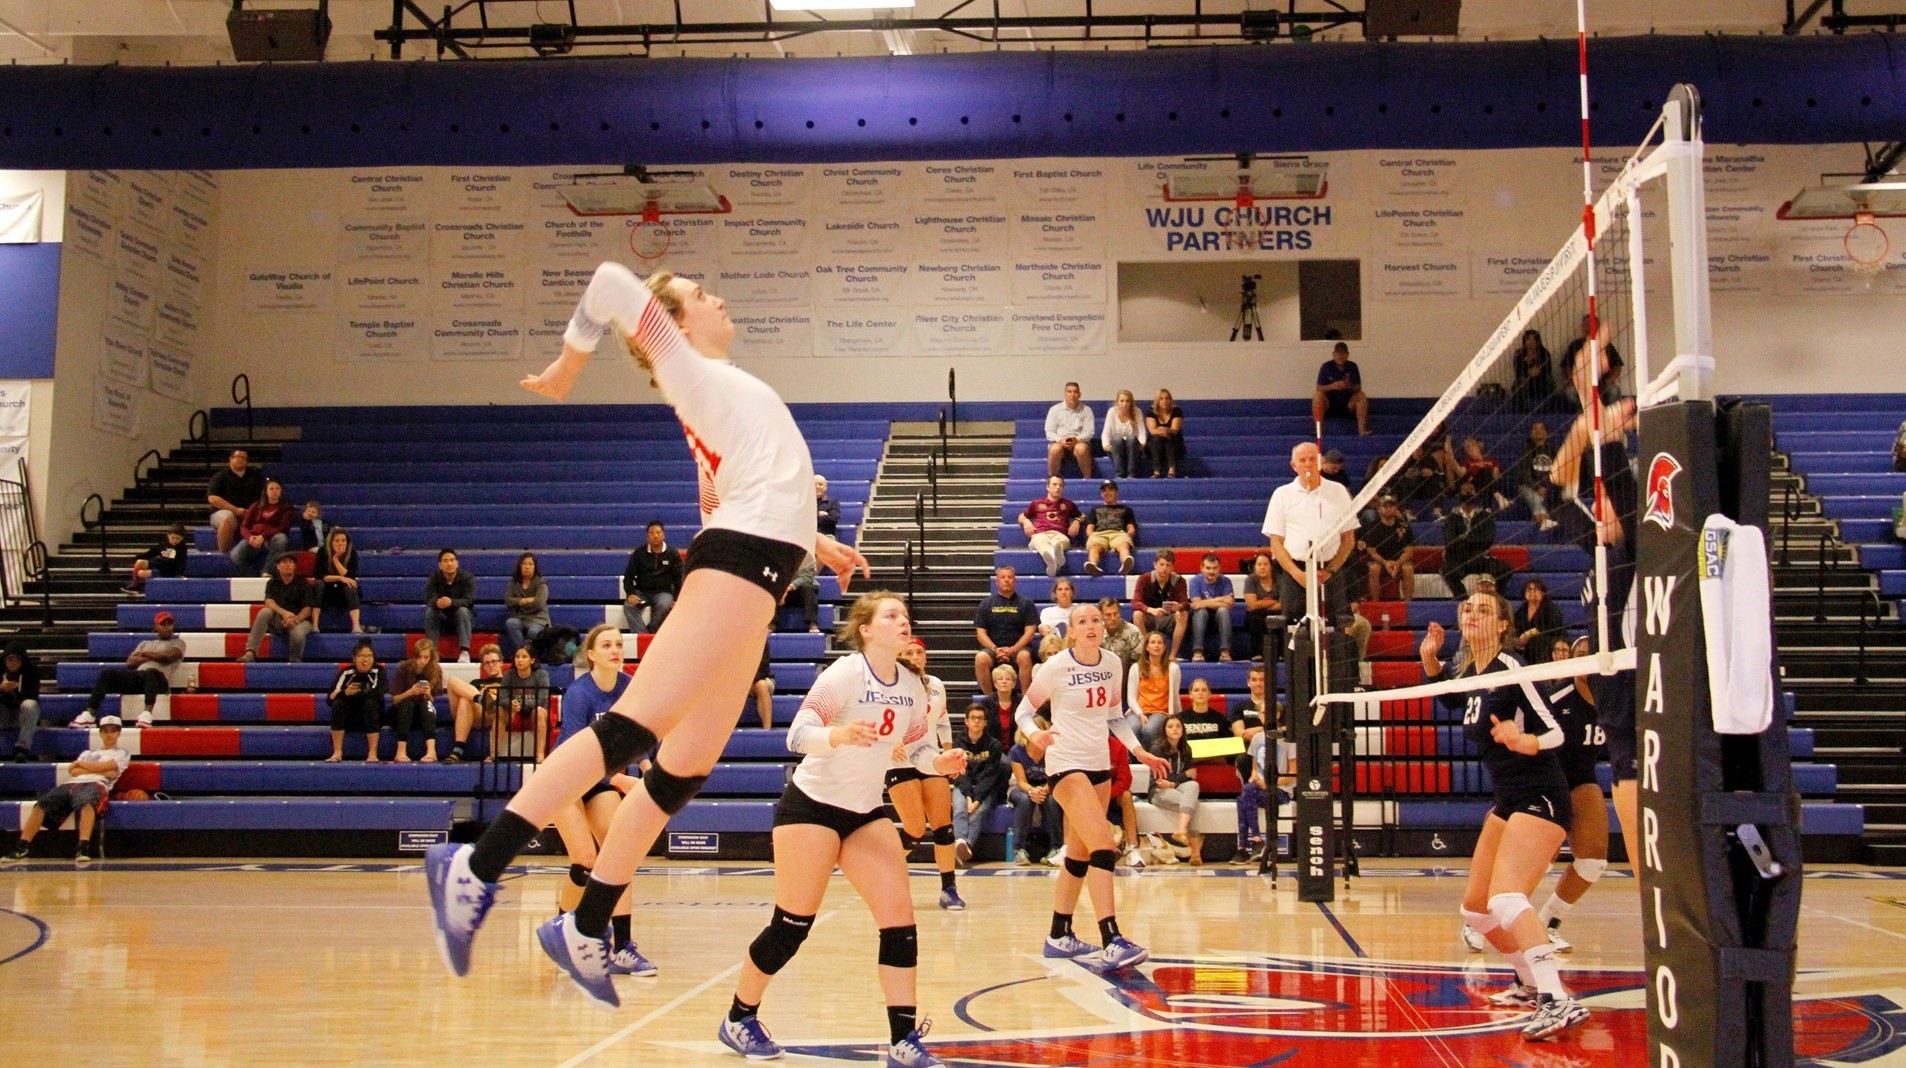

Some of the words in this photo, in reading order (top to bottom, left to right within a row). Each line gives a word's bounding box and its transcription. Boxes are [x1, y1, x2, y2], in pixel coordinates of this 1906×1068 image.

[1157, 162, 1207, 170] Community
[1380, 159, 1412, 167] Central
[823, 168, 849, 177] Christ
[852, 168, 902, 178] Community
[926, 166, 949, 174] Ceres
[951, 165, 994, 174] Christian
[1014, 170, 1033, 178] First
[1036, 170, 1068, 179] Baptist
[1070, 169, 1102, 178] Church
[385, 175, 423, 183] Christian
[451, 175, 470, 183] First
[473, 174, 511, 182] Christian
[730, 171, 761, 179] Destiny
[944, 175, 976, 183] Church
[846, 177, 878, 186] Church
[371, 184, 402, 193] Church
[465, 184, 496, 192] Church
[1021, 215, 1051, 223] Mosaic
[1055, 214, 1096, 222] Christian
[1146, 208, 1204, 227] WJU
[1214, 206, 1331, 227] CHURCH
[1375, 210, 1420, 218] LifePointe
[545, 220, 577, 229] Church
[580, 220, 590, 228] of
[591, 220, 604, 228] the
[724, 220, 756, 228] Impact
[758, 219, 806, 227] Community
[915, 216, 963, 226] Lighthouse
[966, 215, 1006, 224] Christian
[345, 224, 394, 233] Community
[396, 223, 425, 232] Baptist
[435, 223, 483, 231] Crossroads
[485, 223, 524, 231] Christian
[826, 222, 865, 230] Lakeside
[867, 221, 900, 230] Church
[944, 225, 977, 234] Church
[1042, 224, 1075, 233] Church
[464, 232, 495, 241] Church
[556, 229, 593, 238] Foothills
[749, 228, 781, 236] Church
[370, 233, 400, 241] Church
[1487, 257, 1509, 265] First
[1728, 254, 1770, 262] Christian
[1793, 254, 1814, 262] First
[816, 265, 833, 273] Oak
[836, 265, 855, 273] Tree
[858, 264, 908, 274] Community
[918, 264, 958, 274] Newberg
[961, 264, 1001, 272] Christian
[1015, 263, 1058, 271] Northside
[1061, 262, 1101, 271] Christian
[1423, 263, 1456, 271] Church
[1503, 267, 1539, 275] Church
[1708, 264, 1741, 273] Church
[1809, 264, 1844, 272] Church
[289, 272, 321, 281] Church
[322, 272, 331, 280] of
[486, 271, 504, 279] Hills
[778, 271, 809, 279] Church
[845, 274, 878, 283] Church
[943, 273, 976, 282] Church
[1042, 272, 1075, 281] Church
[348, 277, 385, 286] LifePoint
[388, 276, 418, 285] Church
[442, 280, 480, 289] Christian
[483, 280, 514, 289] Church
[732, 316, 766, 324] eatland
[769, 316, 810, 324] Christian
[915, 315, 938, 323] River
[941, 315, 959, 325] City
[961, 314, 1004, 323] Christian
[1012, 314, 1054, 323] Groveland
[1056, 313, 1105, 323] Evangelical
[350, 321, 381, 330] Temple
[383, 321, 414, 330] Baptist
[452, 320, 502, 328] Crossroads
[826, 320, 843, 328] The
[846, 320, 863, 328] Life
[866, 320, 897, 328] Center
[942, 324, 976, 333] Church
[1032, 323, 1050, 332] Free
[1053, 323, 1085, 332] Church
[435, 329, 485, 338] Community
[487, 328, 518, 337] Church
[748, 326, 780, 334] Church
[366, 331, 397, 339] Church
[1704, 530, 1720, 577] GSAC
[1068, 671, 1113, 686] JESSUP
[858, 690, 914, 707] JESSUP
[1085, 686, 1107, 709] 18
[1463, 696, 1482, 725] 23
[878, 708, 896, 736] 8
[1184, 723, 1219, 735] SENIORS
[1583, 724, 1607, 746] 18
